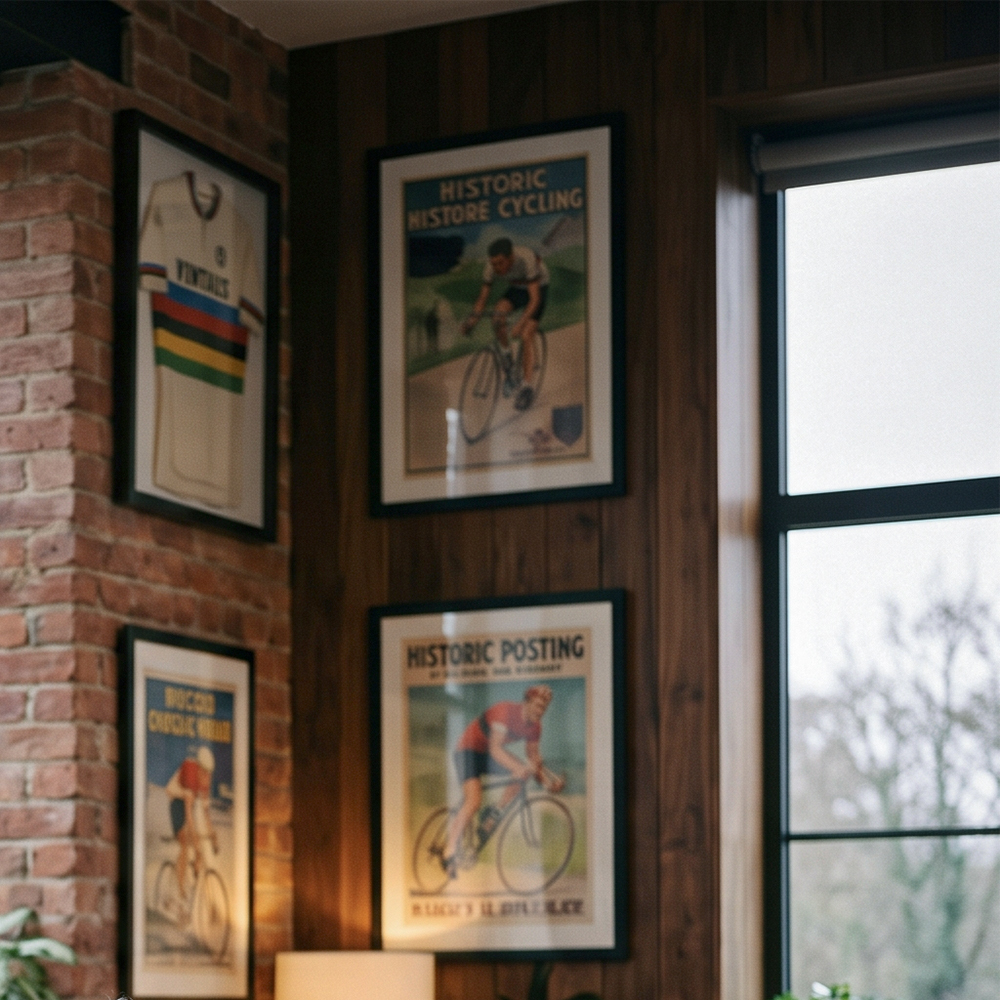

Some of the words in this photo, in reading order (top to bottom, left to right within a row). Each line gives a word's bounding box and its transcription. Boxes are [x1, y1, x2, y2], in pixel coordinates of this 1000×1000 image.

[439, 167, 548, 202] HISTORIC
[406, 201, 490, 232] HISTORE
[497, 187, 583, 219] CYCLING
[406, 639, 495, 669] HISTORIC
[501, 634, 585, 663] POSTING
